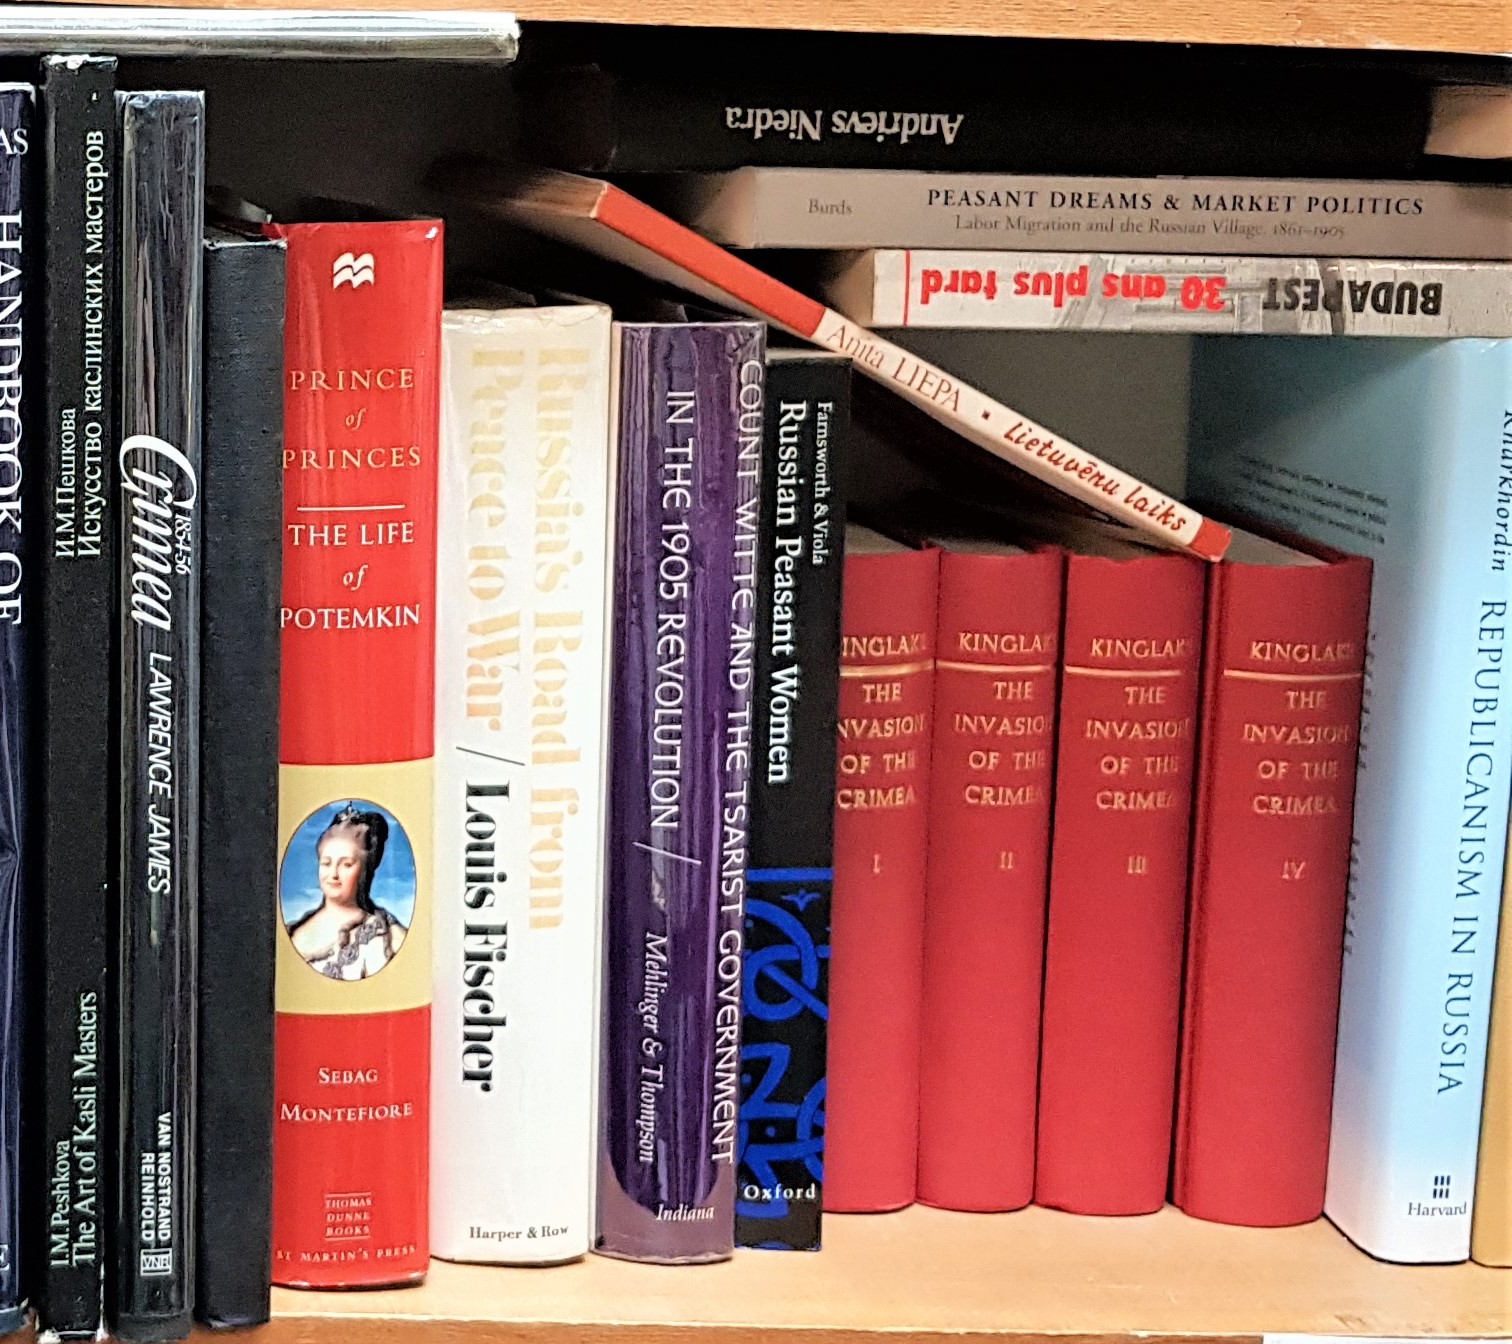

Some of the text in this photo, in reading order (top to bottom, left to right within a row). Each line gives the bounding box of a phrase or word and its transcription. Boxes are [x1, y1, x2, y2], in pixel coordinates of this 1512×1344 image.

[726, 106, 964, 146] Andrievs Niedra
[928, 189, 1039, 208] PEASANT
[1164, 192, 1181, 211] &
[1192, 192, 1295, 214] MARKET
[1306, 195, 1424, 216] POLITICS
[920, 265, 1226, 312] 30 ans plus tard
[77, 130, 104, 556] Искусство каслинских мастеров
[291, 368, 414, 392] PRINCE
[826, 323, 963, 412] Anita LIEPA
[282, 446, 422, 471] PRINCES
[119, 435, 197, 629] Crimea
[289, 522, 415, 546] THE LIFE
[279, 604, 421, 630] POTEMKIN
[462, 780, 510, 1094] Louis Fischer
[1436, 915, 1476, 1097] IN RUSSIA
[744, 1184, 817, 1201] Oxford
[1408, 1202, 1467, 1217] Harvard
[469, 1224, 569, 1242] Harper & Row
